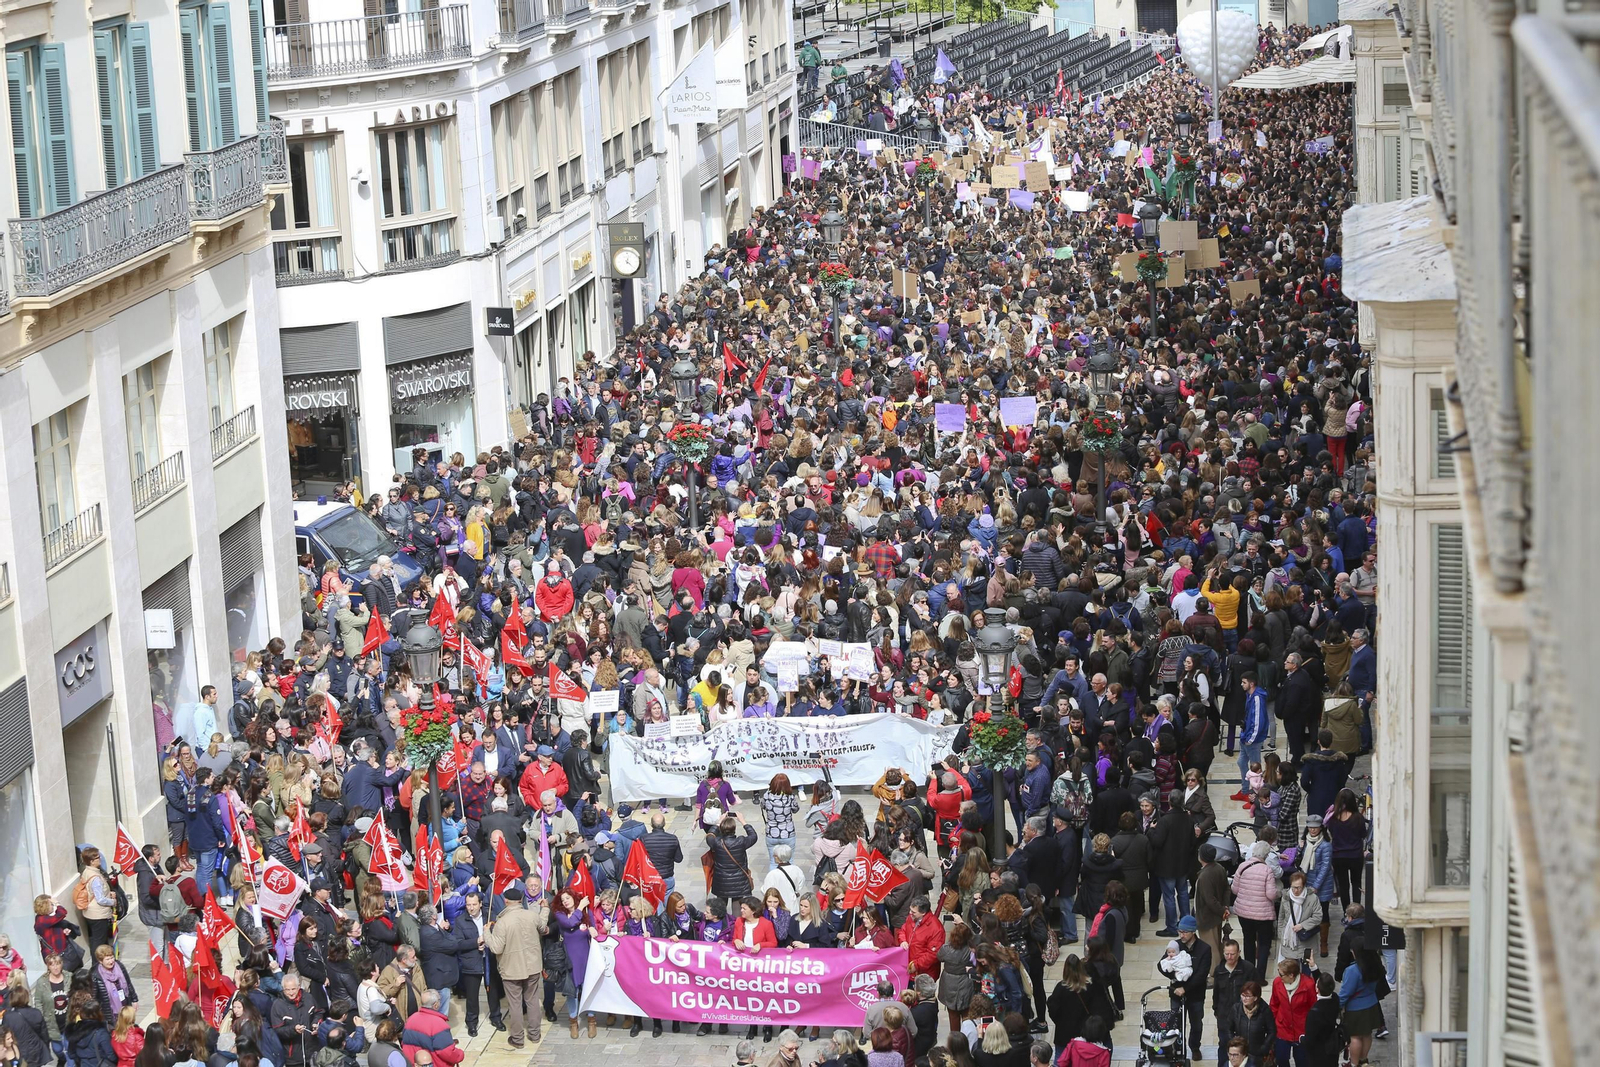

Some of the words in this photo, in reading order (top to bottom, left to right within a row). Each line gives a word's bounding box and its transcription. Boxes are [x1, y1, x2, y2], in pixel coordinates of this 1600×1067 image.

[671, 91, 711, 103] LARIOS
[373, 99, 458, 127] LARIOS
[397, 370, 471, 400] SWAROVSKI
[61, 645, 95, 688] COS
[872, 860, 891, 882] UGT
[643, 940, 713, 969] UGT
[719, 950, 826, 977] feminista
[648, 967, 690, 985] Una
[694, 974, 790, 994] sociedad
[794, 982, 822, 994] en
[851, 969, 889, 989] UGT
[671, 991, 801, 1015] IGUALDAD
[701, 1013, 772, 1023] #VivasLibresUnidas
